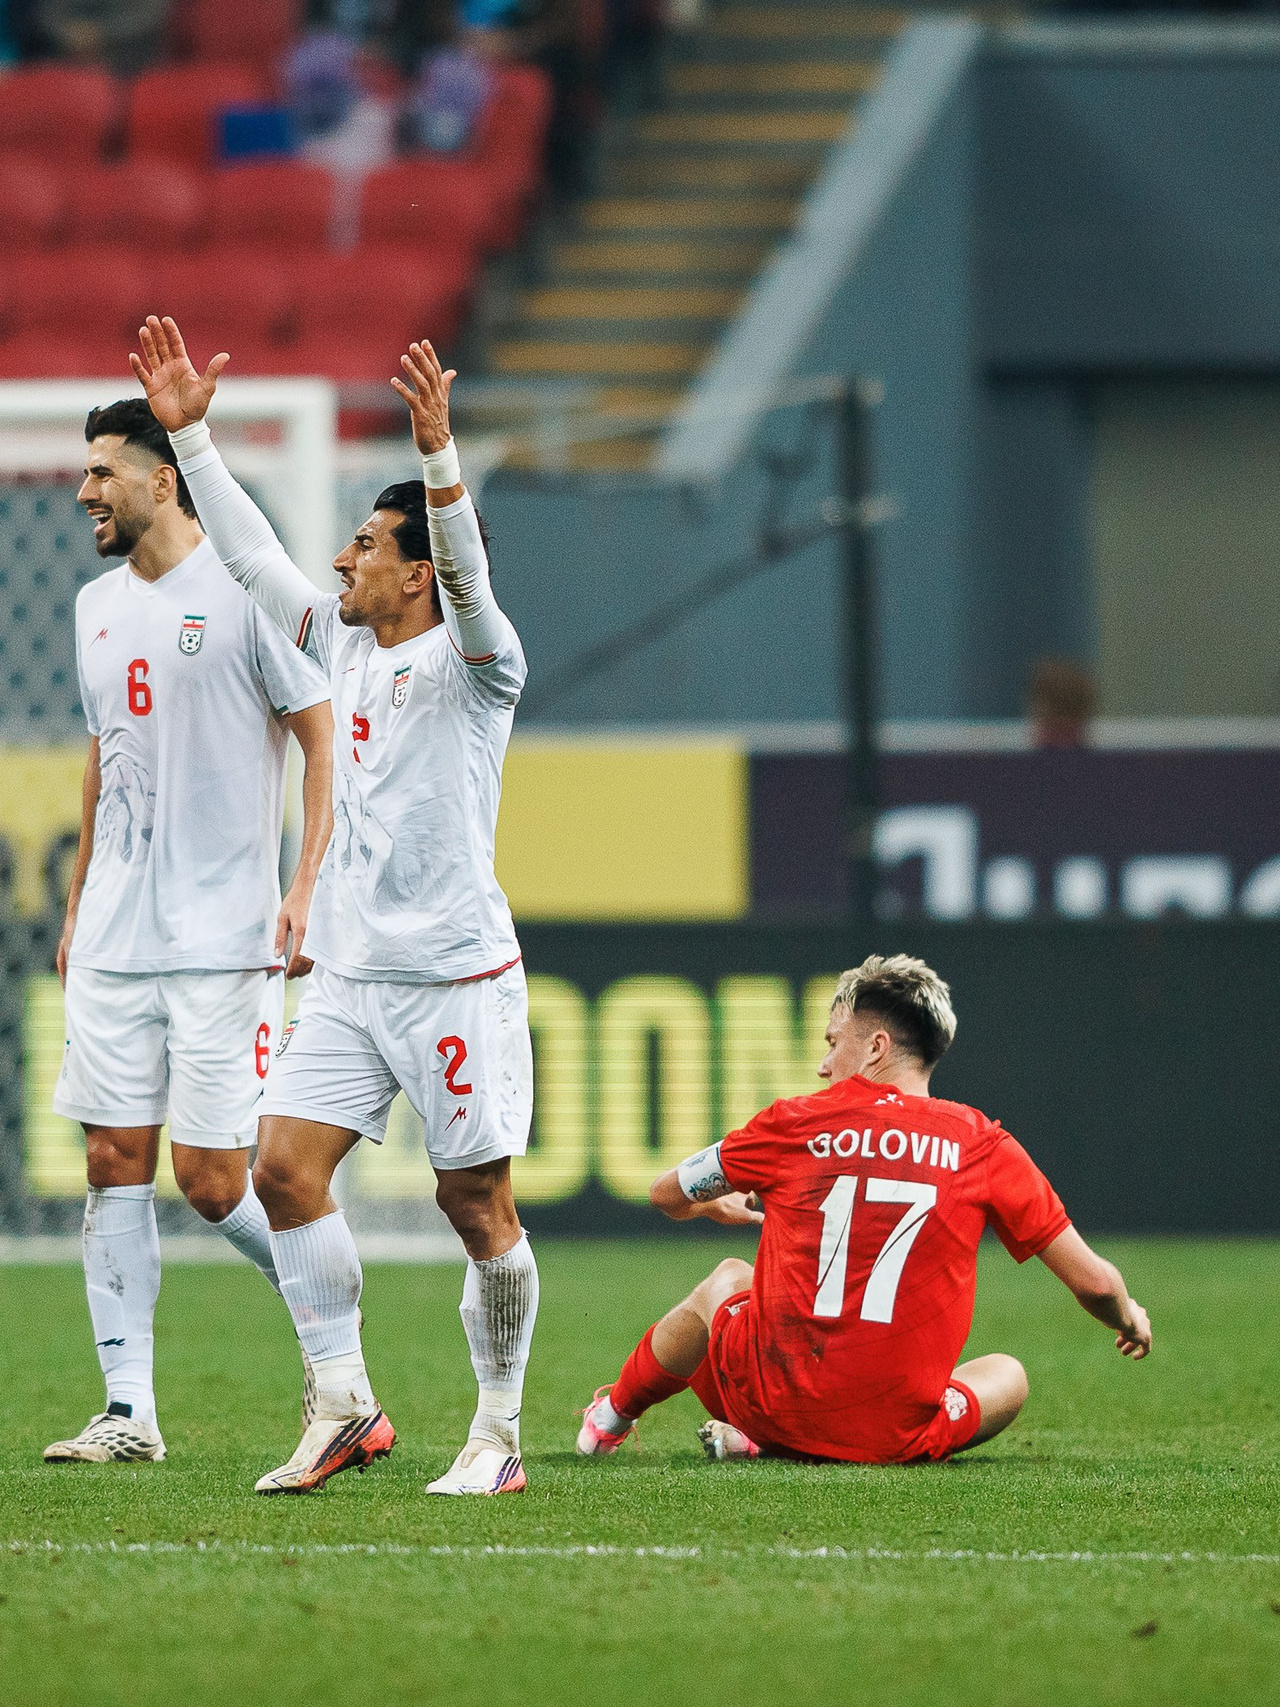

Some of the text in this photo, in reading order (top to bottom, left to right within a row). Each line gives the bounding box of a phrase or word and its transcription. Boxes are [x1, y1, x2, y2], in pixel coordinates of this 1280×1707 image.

[127, 658, 153, 717] 6
[254, 1021, 271, 1080] 6
[436, 1034, 474, 1096] 2
[806, 1128, 960, 1171] GOLOVIN
[812, 1175, 938, 1324] 17
